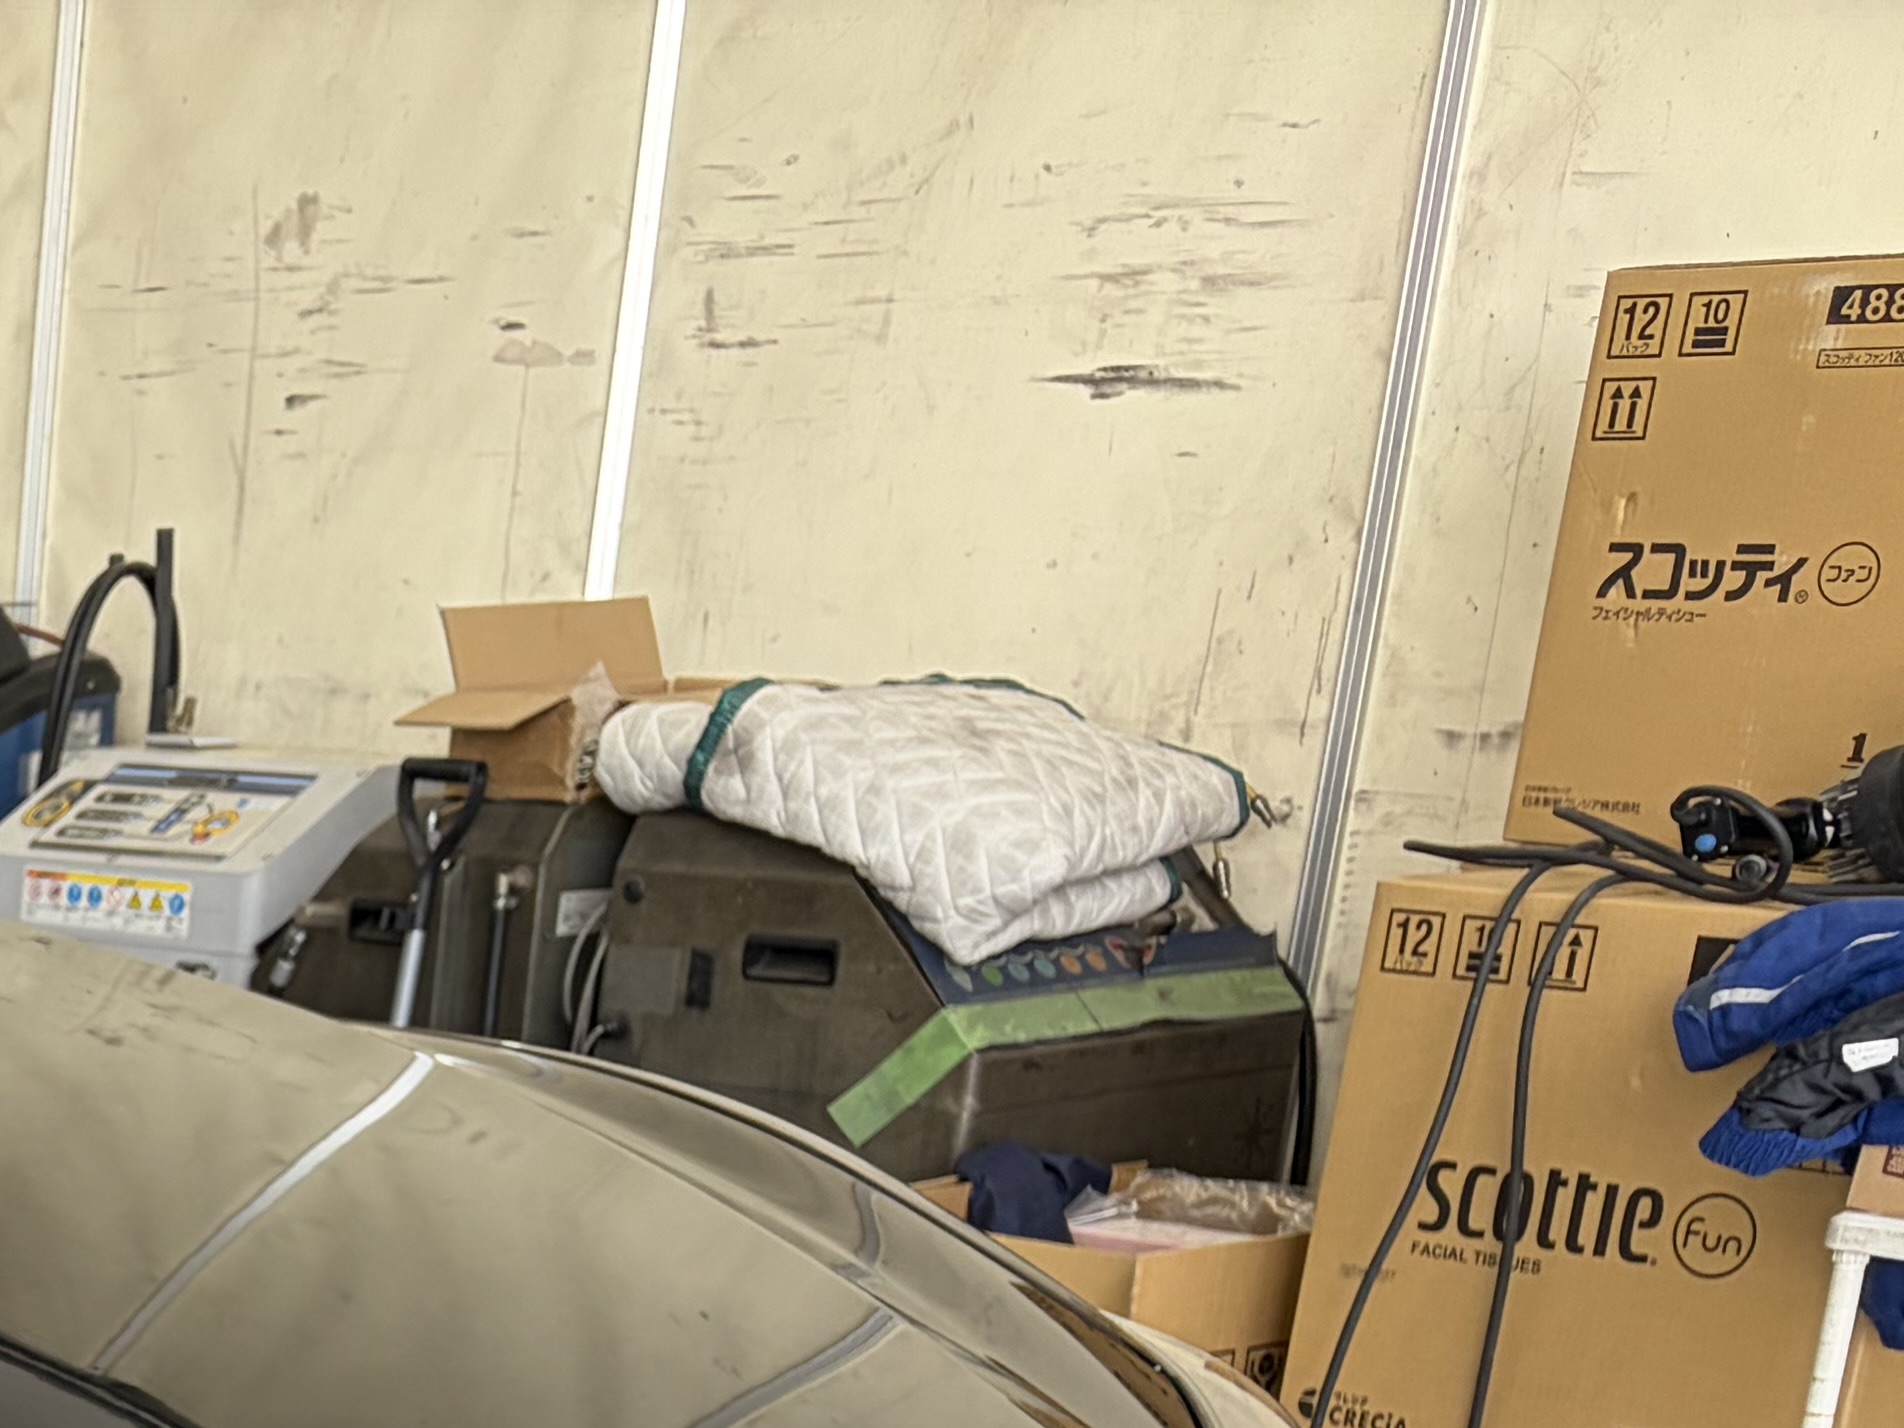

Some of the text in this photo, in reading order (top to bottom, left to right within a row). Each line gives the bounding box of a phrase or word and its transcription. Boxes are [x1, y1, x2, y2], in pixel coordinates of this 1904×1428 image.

[1622, 300, 1661, 341] 12
[1700, 297, 1731, 325] 10
[1595, 542, 1809, 603] スコッティ
[1825, 565, 1873, 583] ファン
[1396, 915, 1434, 958] 12
[1411, 1240, 1467, 1264] FACIAL
